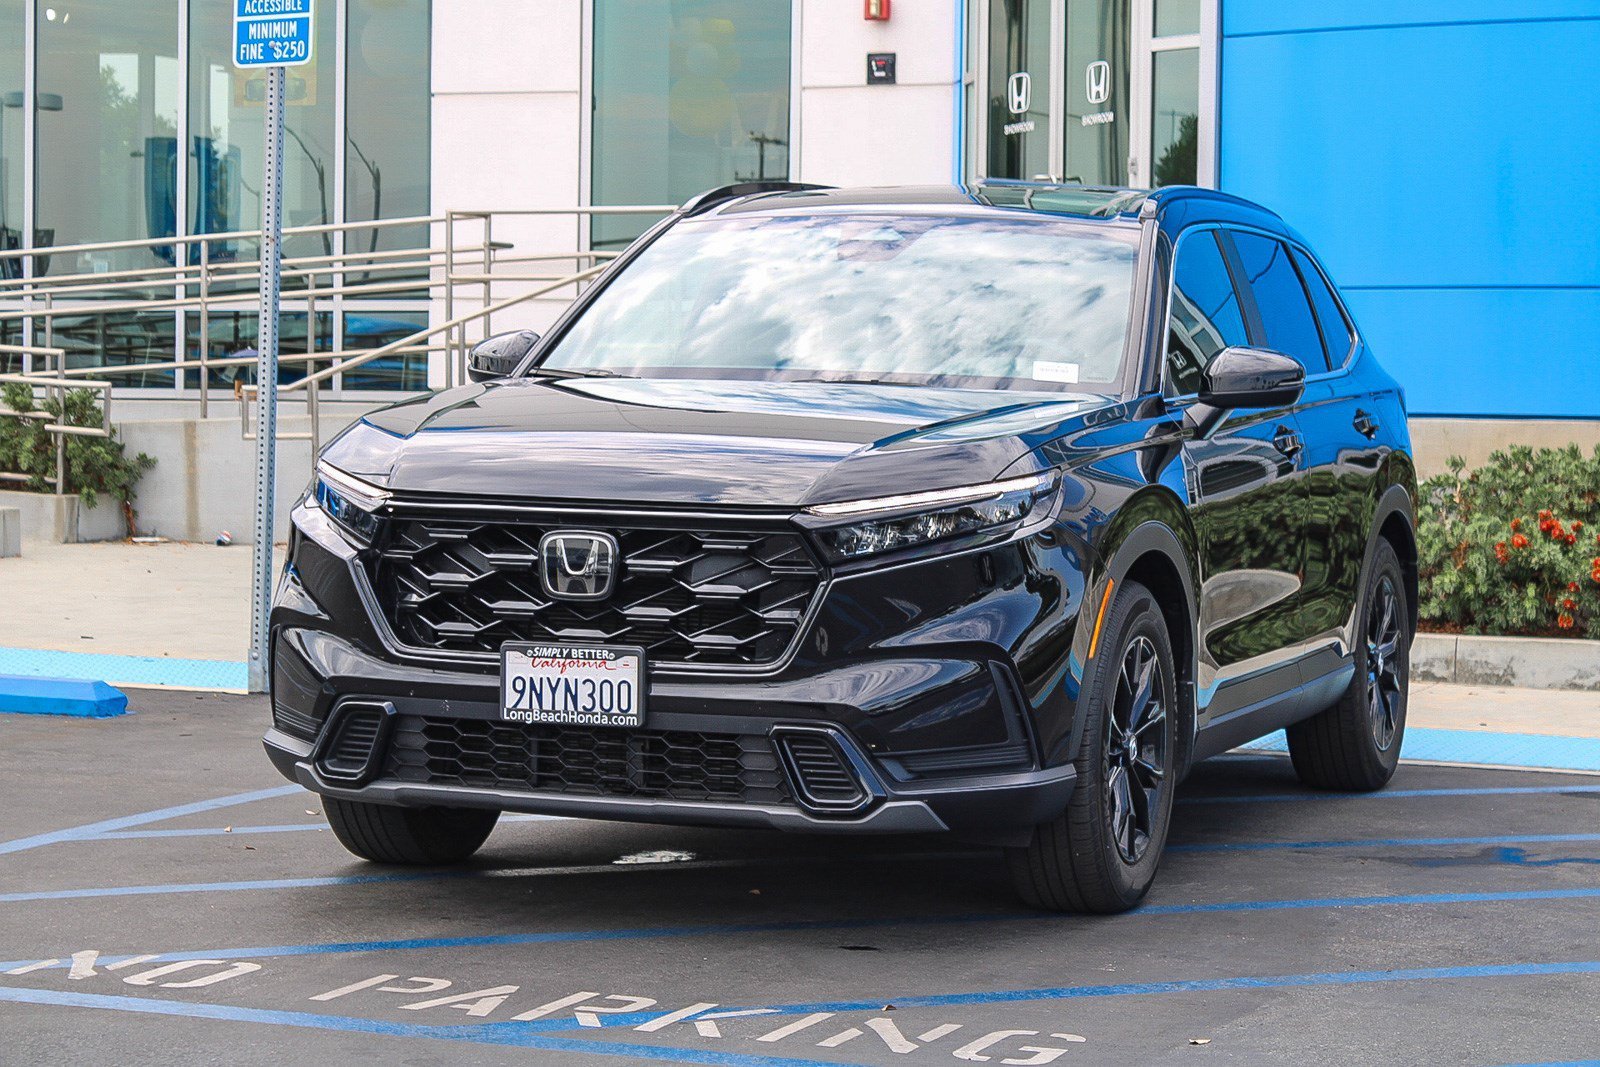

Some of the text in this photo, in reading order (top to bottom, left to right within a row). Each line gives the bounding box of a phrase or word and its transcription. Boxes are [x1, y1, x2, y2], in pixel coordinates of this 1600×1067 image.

[244, 0, 303, 14] ACCESSIBLE
[248, 21, 297, 39] MINIMUM
[240, 40, 305, 60] FINE $250
[532, 647, 608, 660] SIMPLY BETTER
[531, 657, 616, 674] California
[511, 675, 632, 714] 9NYN300
[503, 707, 638, 726] LongBeachHonda.com
[2, 950, 1087, 1065] NO PARKING
